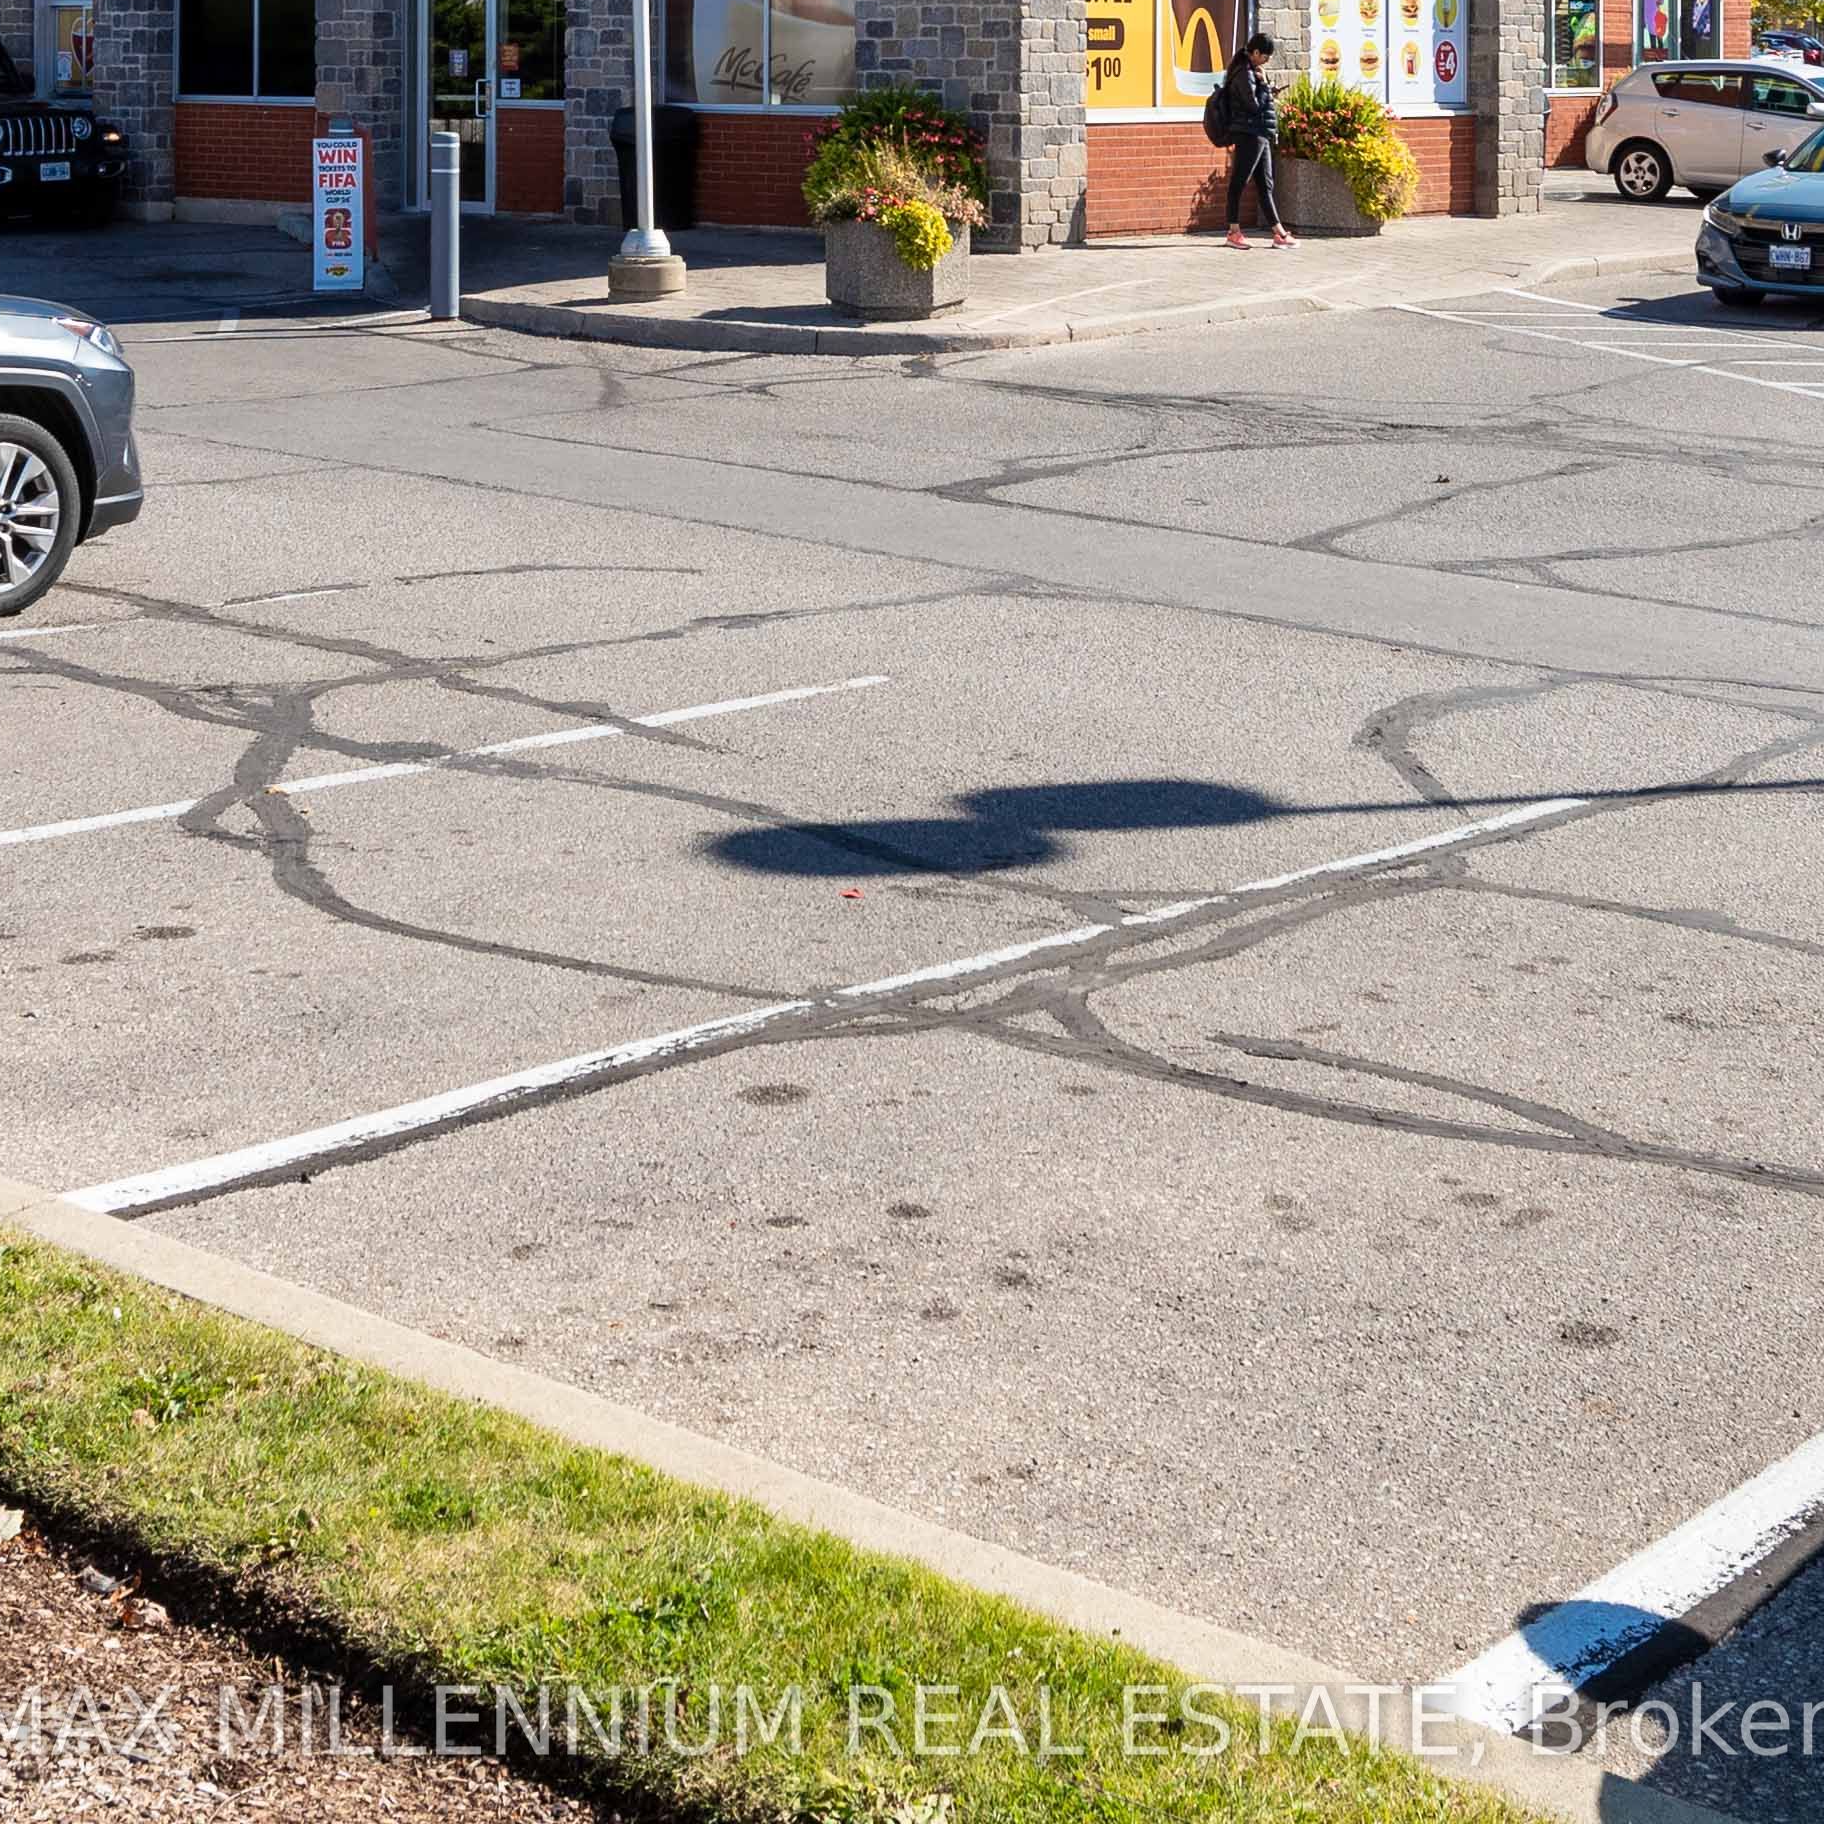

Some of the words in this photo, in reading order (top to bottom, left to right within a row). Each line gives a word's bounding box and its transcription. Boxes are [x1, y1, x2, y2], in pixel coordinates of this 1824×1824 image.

[1088, 25, 1116, 42] small
[712, 46, 816, 96] McCafé
[318, 149, 357, 164] WIN
[319, 173, 357, 188] FIFA
